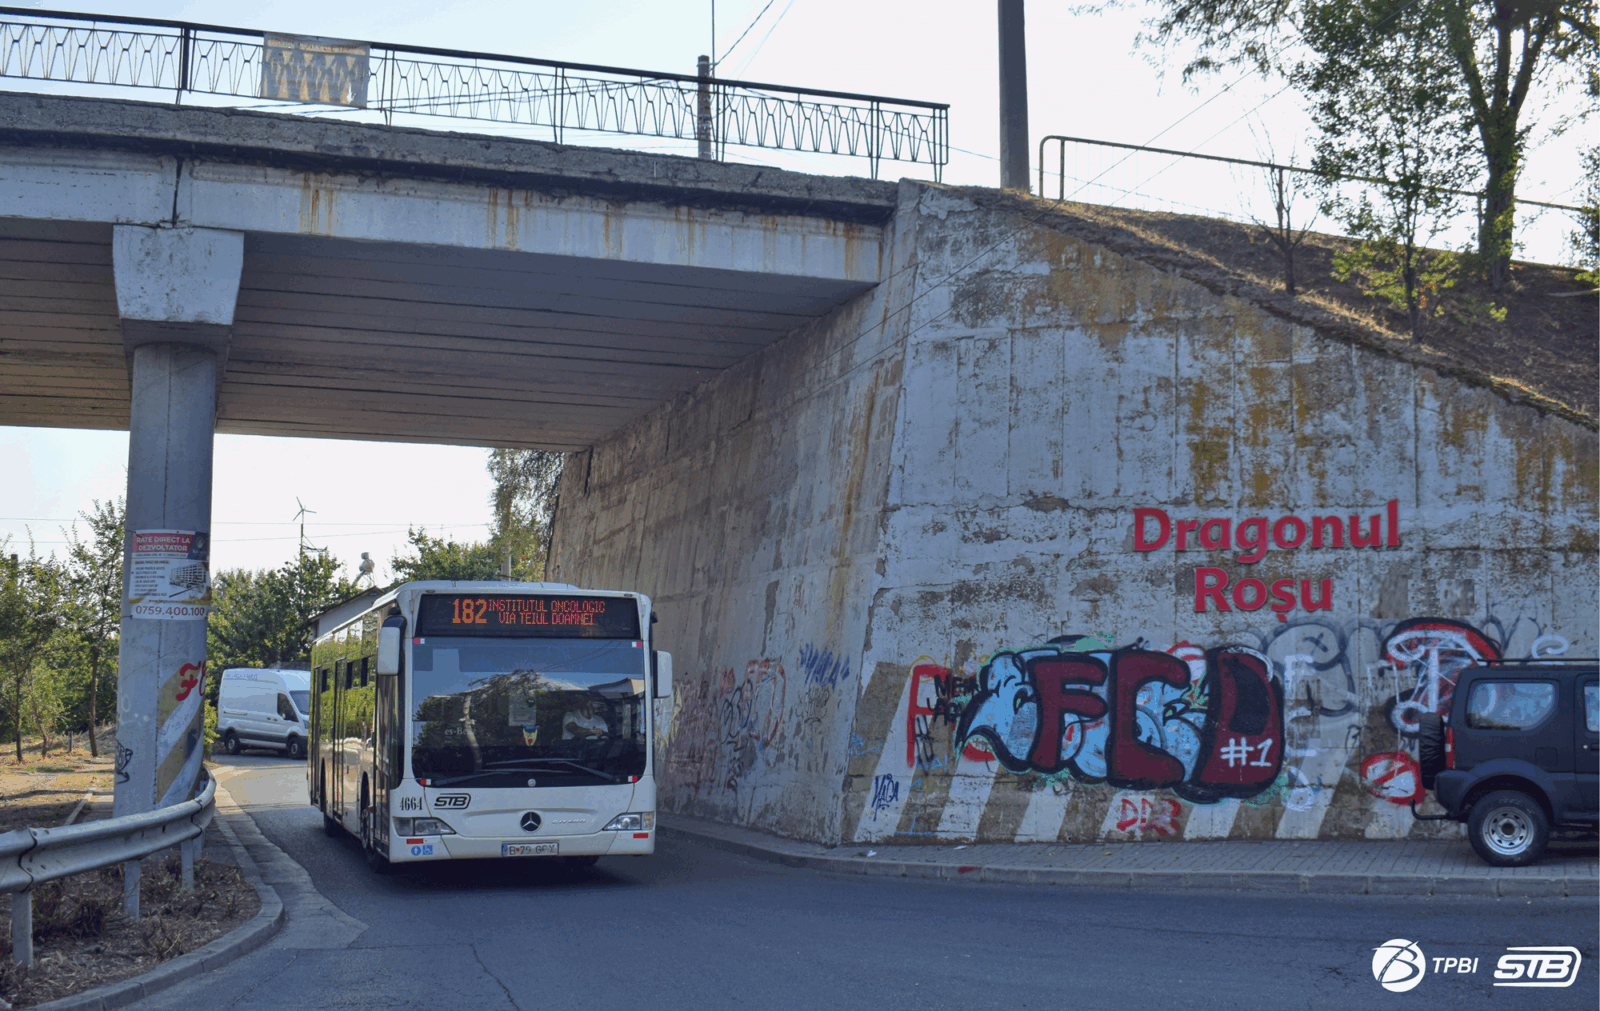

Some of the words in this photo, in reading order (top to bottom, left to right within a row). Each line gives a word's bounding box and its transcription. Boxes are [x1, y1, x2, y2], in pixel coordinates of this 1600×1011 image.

[153, 536, 180, 544] DIRECT
[138, 544, 188, 552] DEZVOLTATOR
[135, 605, 205, 616] 0759.400.100
[452, 598, 488, 624] 182
[488, 599, 548, 612] INSTITUTUL
[551, 600, 606, 613] ONCOLOGIC
[499, 612, 517, 624] VIA
[520, 612, 549, 625] TEIUL
[551, 612, 594, 625] DOAMNEI
[400, 796, 423, 811] 4664
[434, 796, 469, 808] STB
[508, 845, 517, 856] B
[520, 845, 532, 855] 79
